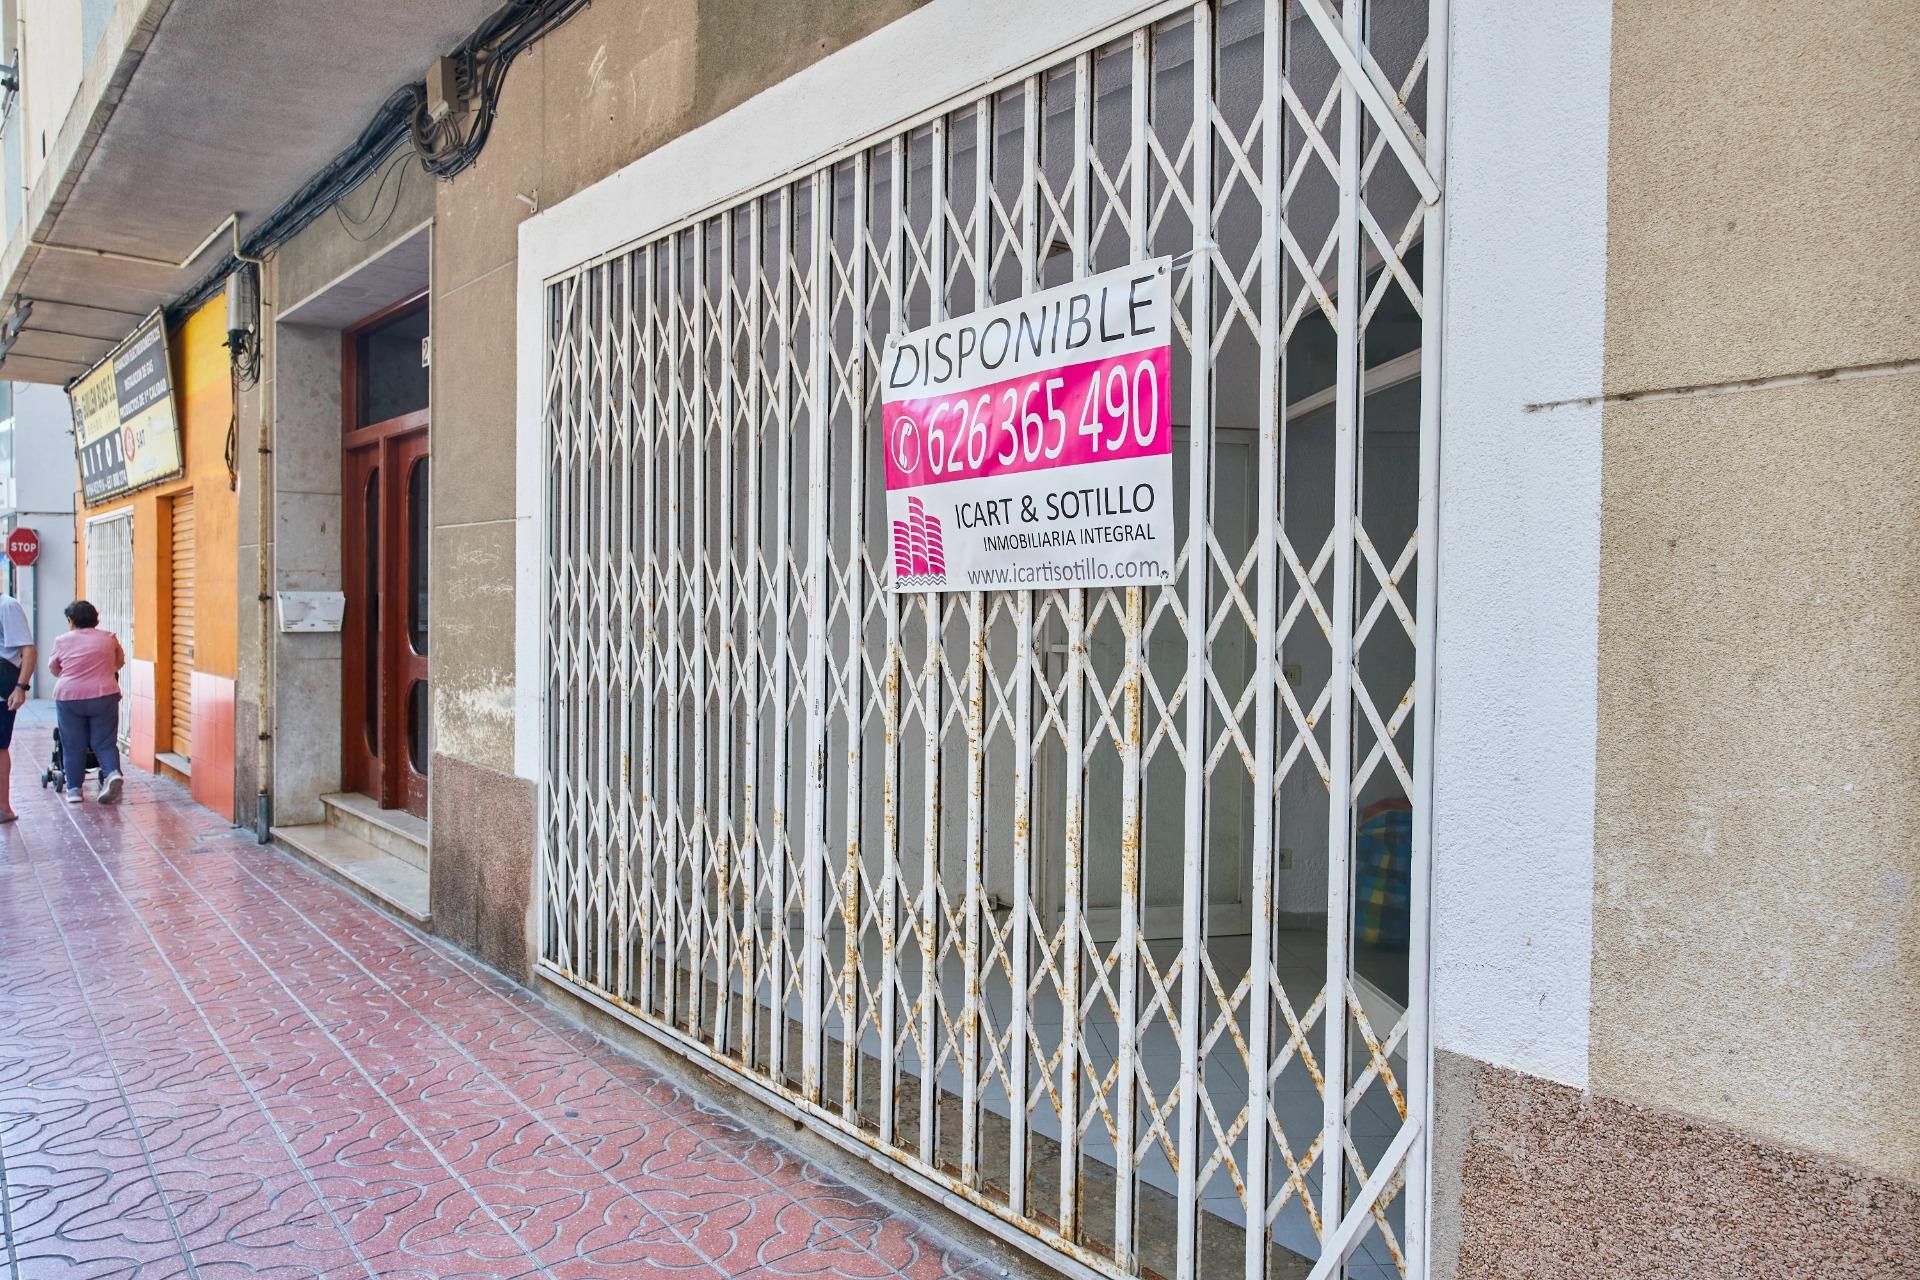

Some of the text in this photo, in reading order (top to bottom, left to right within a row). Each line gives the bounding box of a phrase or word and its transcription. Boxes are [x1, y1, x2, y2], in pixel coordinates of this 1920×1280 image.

[889, 274, 1156, 389] DISPONIBLE
[149, 377, 167, 400] CALIDAD
[927, 359, 1158, 476] 626 365 490
[82, 432, 123, 478] AITOR
[955, 482, 1155, 529] ICART & SOTILLO
[11, 542, 36, 552] STOP
[983, 522, 1156, 552] INMOBILIARIA INTEGRAL
[967, 558, 1160, 586] www.icartisotillo.com
